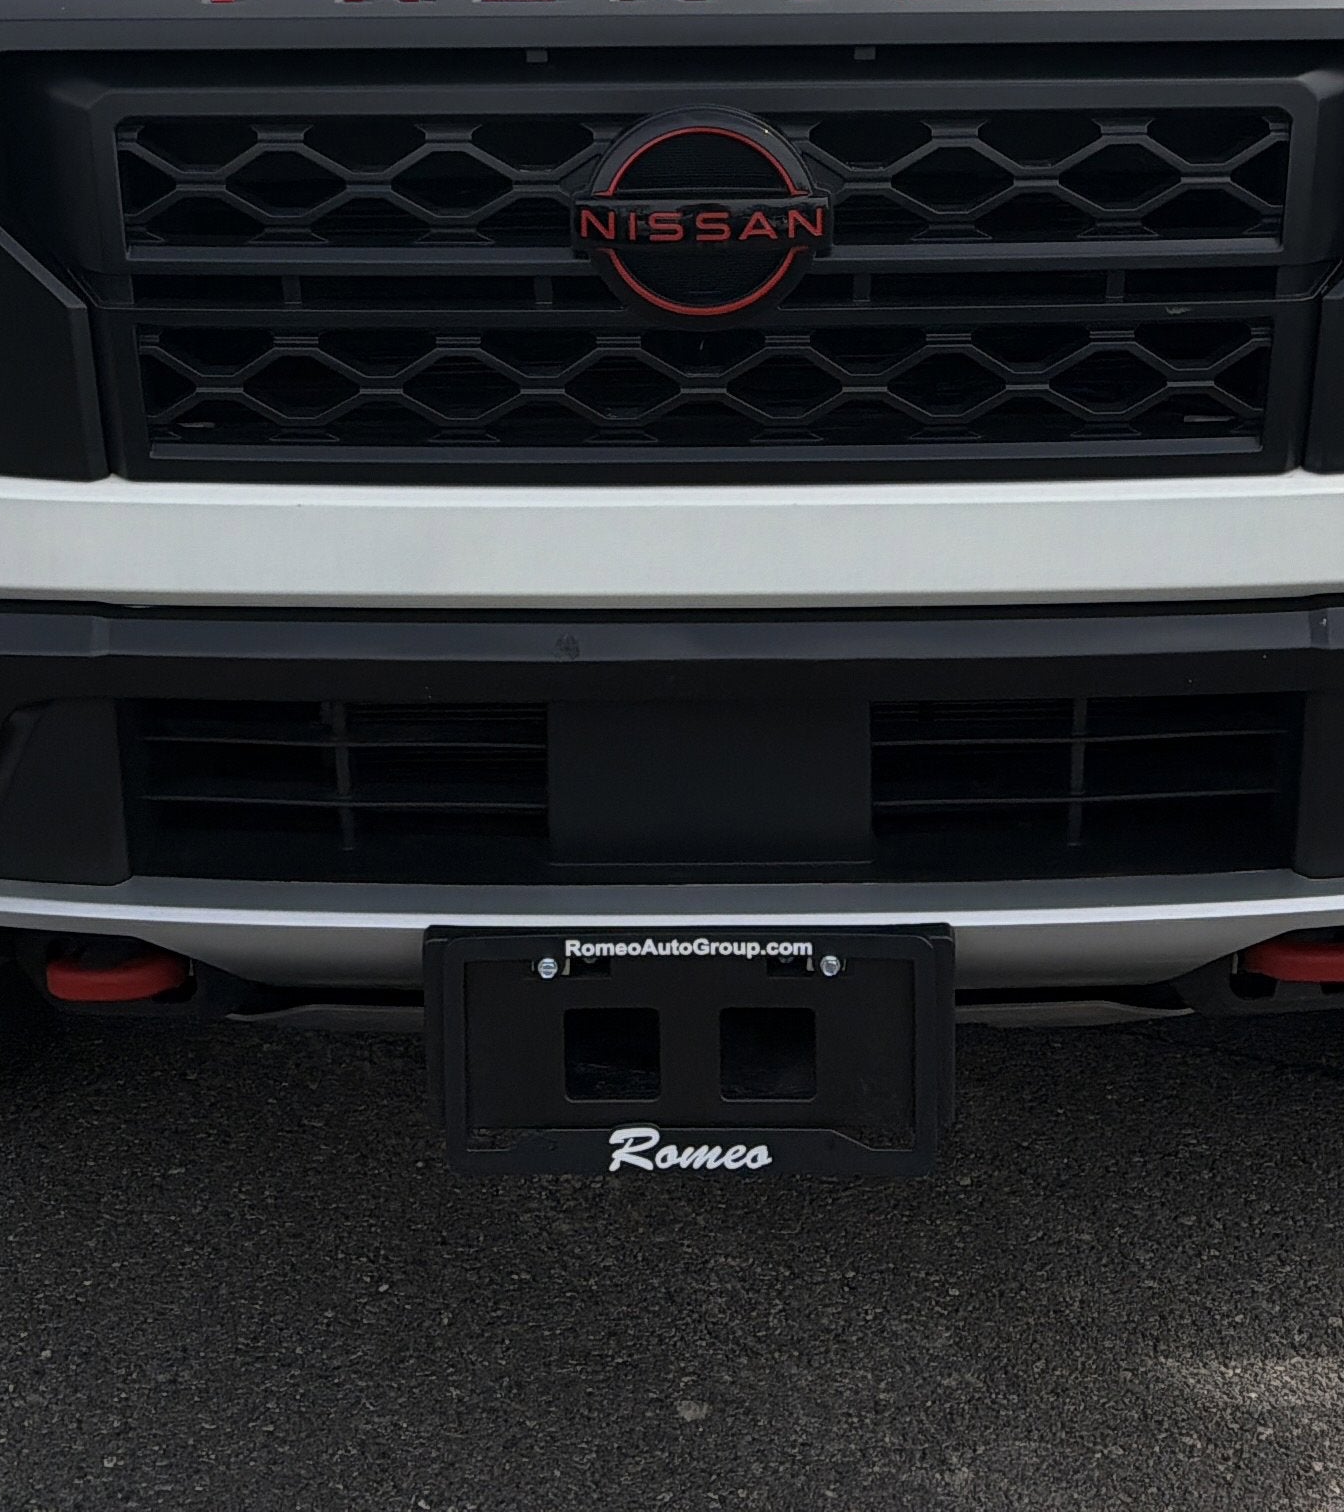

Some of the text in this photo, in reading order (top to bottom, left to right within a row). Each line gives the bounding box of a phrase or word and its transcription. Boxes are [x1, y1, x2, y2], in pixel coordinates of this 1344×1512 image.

[580, 207, 824, 242] NISSAN
[564, 938, 813, 960] RomeoAutoGroup.com
[608, 1126, 773, 1172] Romeo
